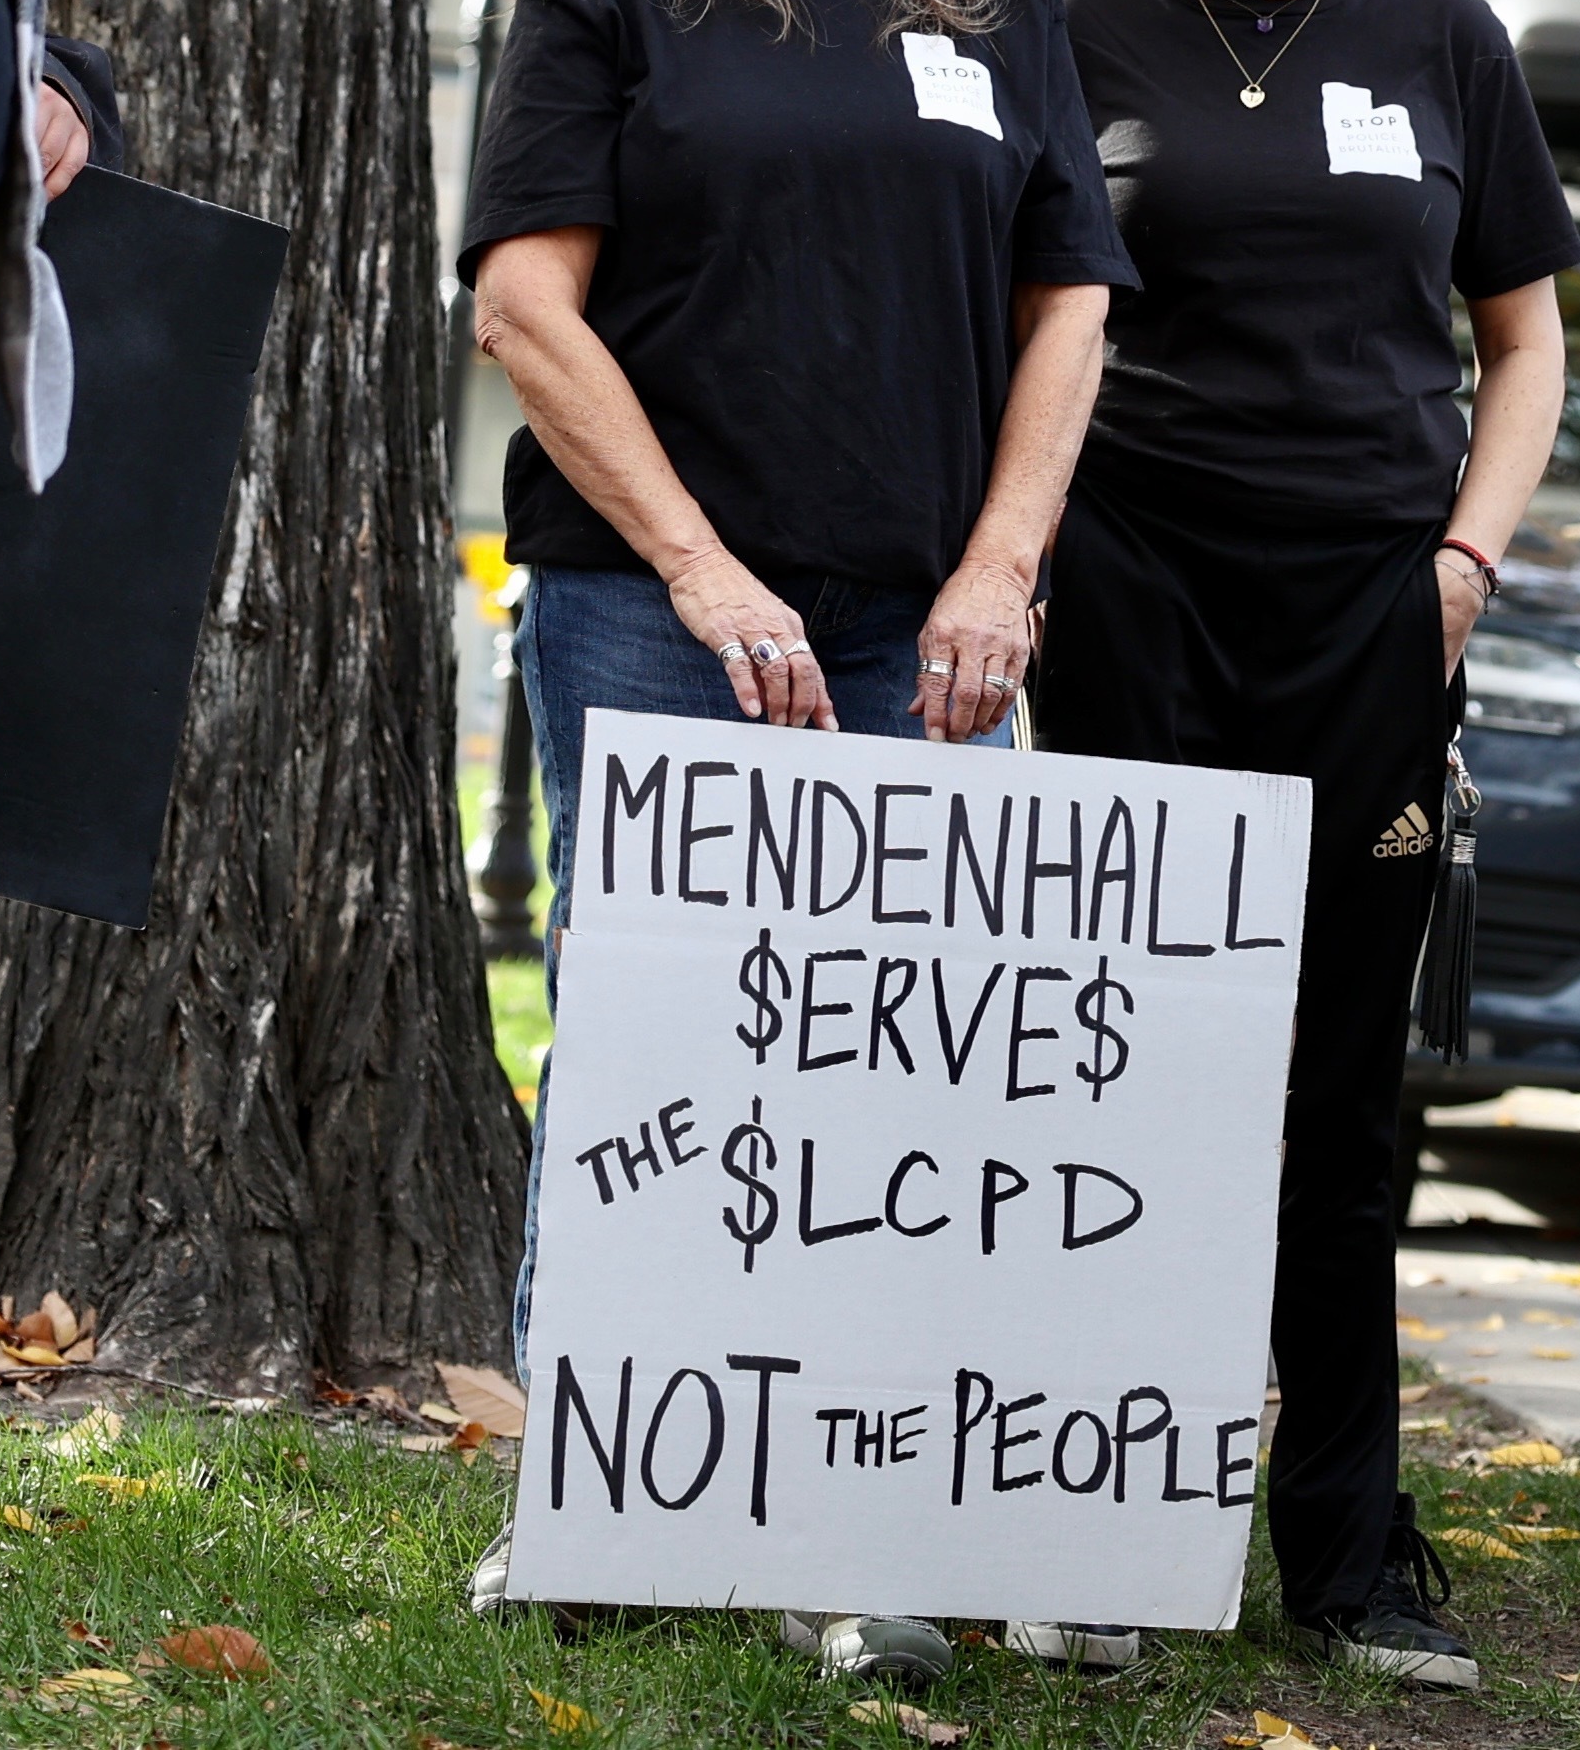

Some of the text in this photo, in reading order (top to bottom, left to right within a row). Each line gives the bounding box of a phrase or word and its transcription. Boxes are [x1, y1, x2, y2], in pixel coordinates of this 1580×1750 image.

[924, 66, 981, 80] STOP
[1339, 144, 1410, 156] BRUTALITY
[1340, 116, 1397, 129] STOP
[1347, 132, 1399, 142] POLICE
[603, 754, 1285, 958] MENDENHALL
[737, 928, 1133, 1102] $ERVE$
[576, 1096, 1142, 1273] THE $LCPD
[552, 1354, 1257, 1526] NOT THE PEOPLE
